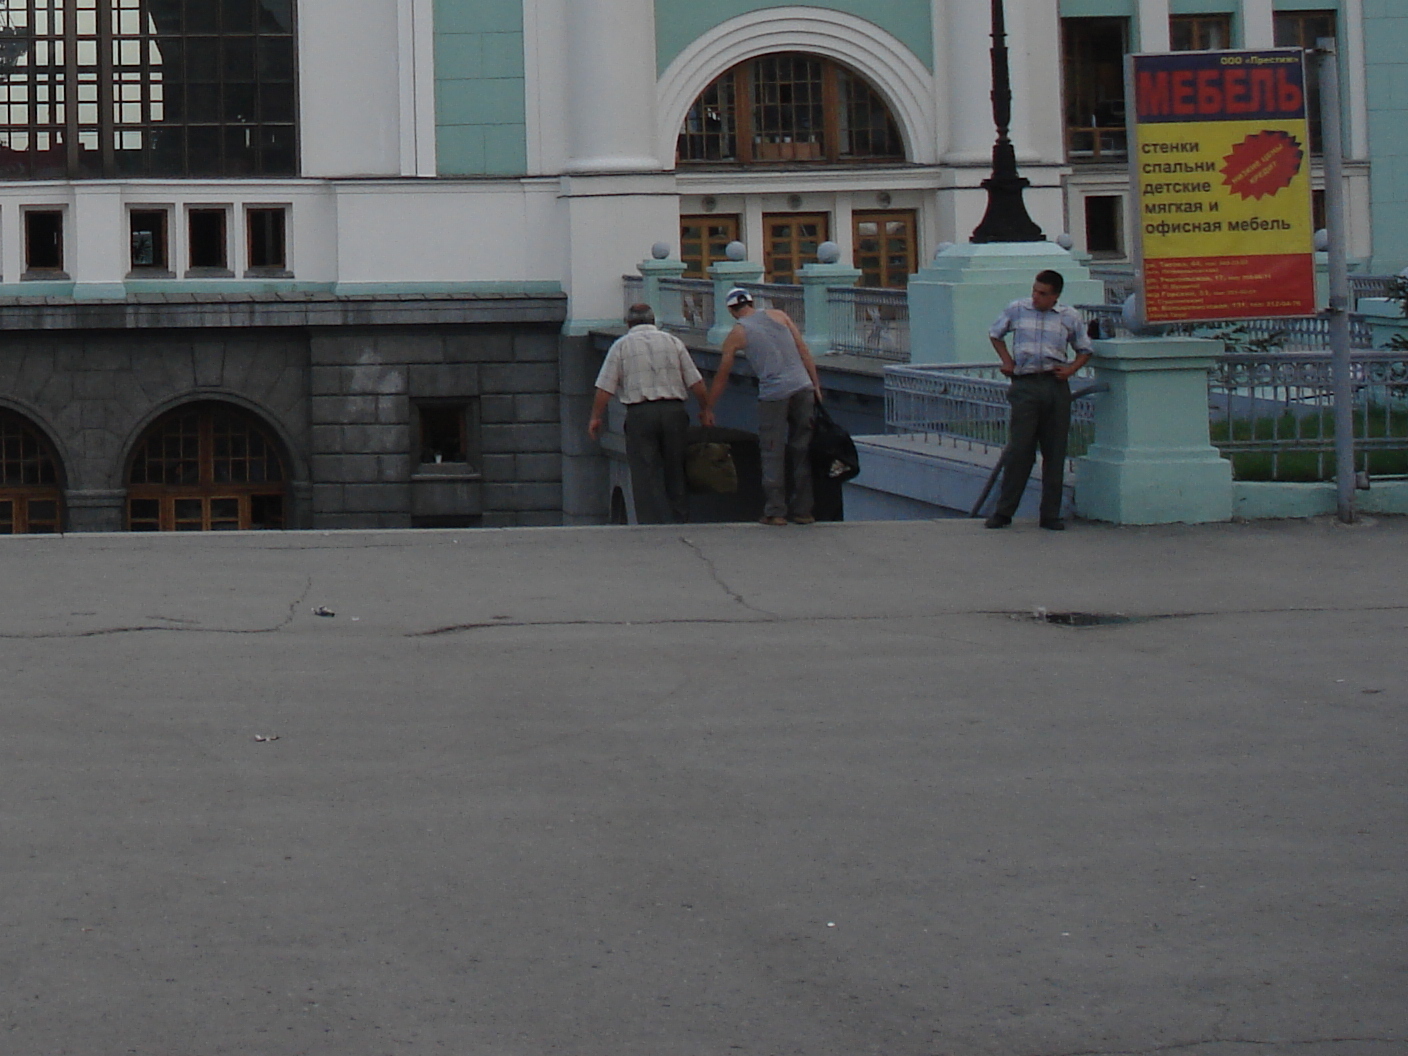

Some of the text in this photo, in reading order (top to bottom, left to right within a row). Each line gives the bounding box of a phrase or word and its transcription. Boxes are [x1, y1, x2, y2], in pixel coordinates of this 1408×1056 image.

[1220, 56, 1242, 65] ООО
[1137, 67, 1303, 116] МЕБЕЛЬ
[1141, 142, 1200, 154] стенки
[1142, 161, 1216, 174] спальни
[1143, 181, 1212, 196] детские
[1145, 201, 1219, 214] мягкая и
[1145, 216, 1291, 237] офисная мебель
